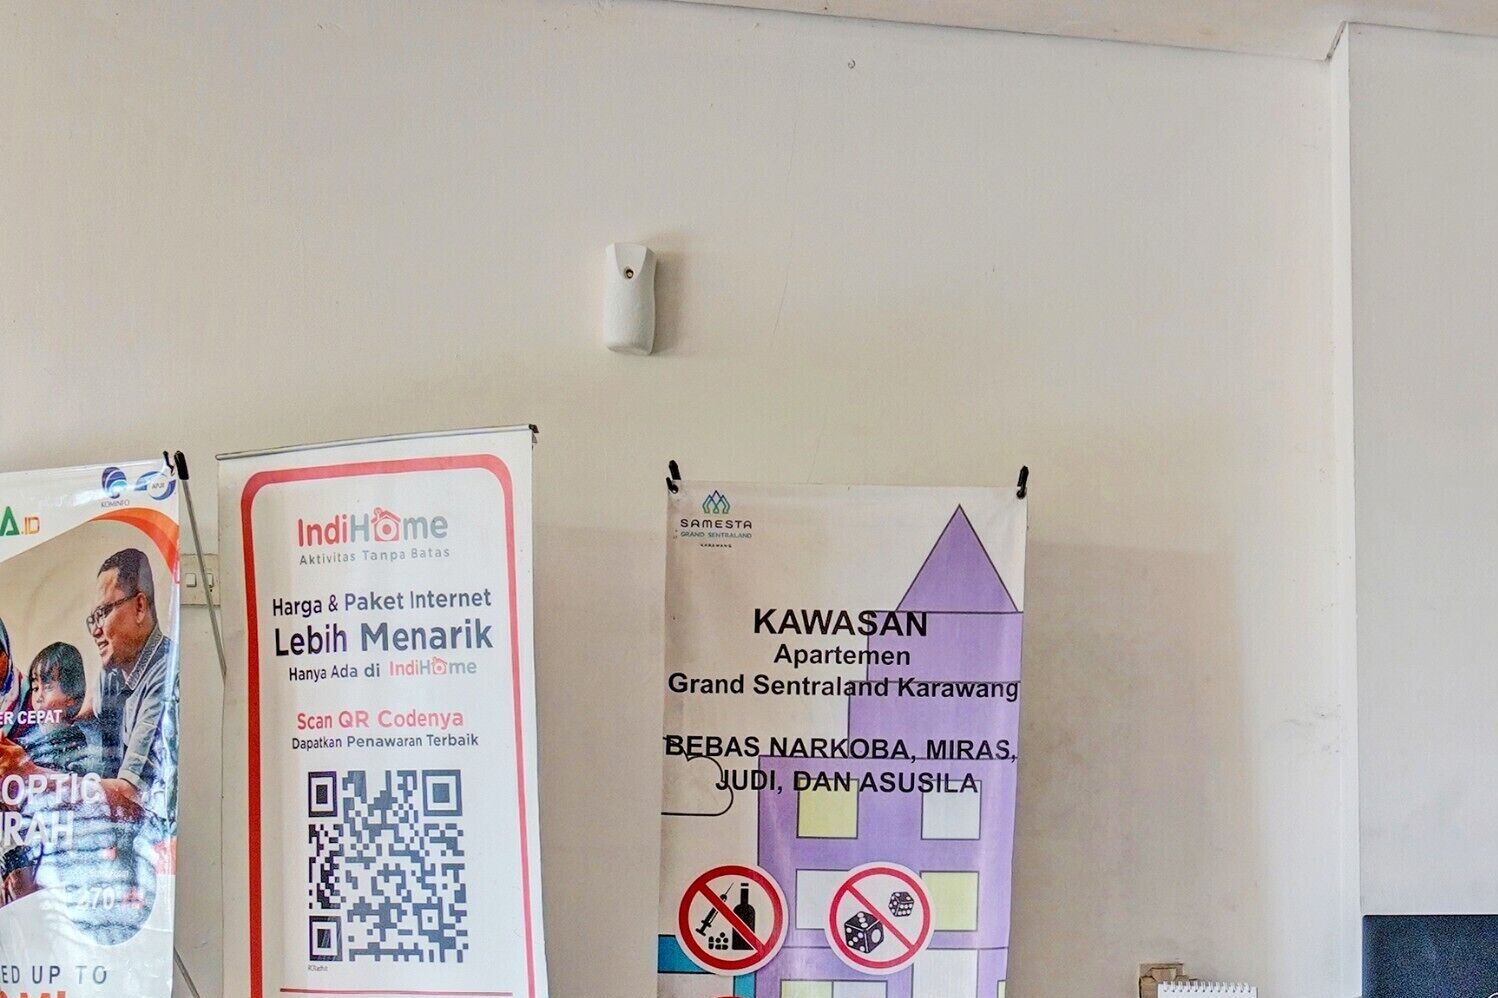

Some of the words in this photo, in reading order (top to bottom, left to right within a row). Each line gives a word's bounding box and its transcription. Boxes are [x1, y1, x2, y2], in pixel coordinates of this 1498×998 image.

[101, 500, 130, 508] KOMINFO
[298, 507, 449, 547] IndiHome
[680, 518, 752, 529] SAMESTA
[300, 553, 356, 565] Aktivitas
[362, 550, 405, 562] Tanpa
[411, 548, 450, 559] Batas
[272, 597, 322, 618] Harga
[328, 594, 338, 612] &
[345, 591, 404, 611] Paket
[410, 588, 492, 609] Internet
[754, 608, 928, 636] KAWASAN
[275, 623, 347, 656] Lebih
[361, 618, 494, 652] Menarik
[774, 643, 911, 668] Apartemen
[289, 666, 327, 682] Hanya
[331, 664, 358, 678] Ada
[364, 663, 380, 677] di
[389, 656, 478, 676] IndiHome
[668, 673, 745, 695] Grand
[754, 674, 889, 697] Sentraland
[898, 678, 1019, 702] Karawang
[18, 709, 63, 725] CEPAT
[297, 713, 332, 730] Scan
[339, 710, 369, 728] QR
[378, 709, 464, 731] Codenya
[292, 736, 342, 751] Dapatkan
[347, 735, 422, 747] Penawaran
[426, 734, 479, 747] Terbaik
[665, 735, 760, 757] BEBAS
[770, 737, 916, 762] NARKOBA,
[927, 740, 1016, 762] MIRAS,
[716, 769, 783, 793] JUDI,
[793, 771, 851, 792] DAN
[859, 772, 979, 793] ASUSILA
[32, 965, 61, 984] UP
[75, 965, 108, 984] TO
